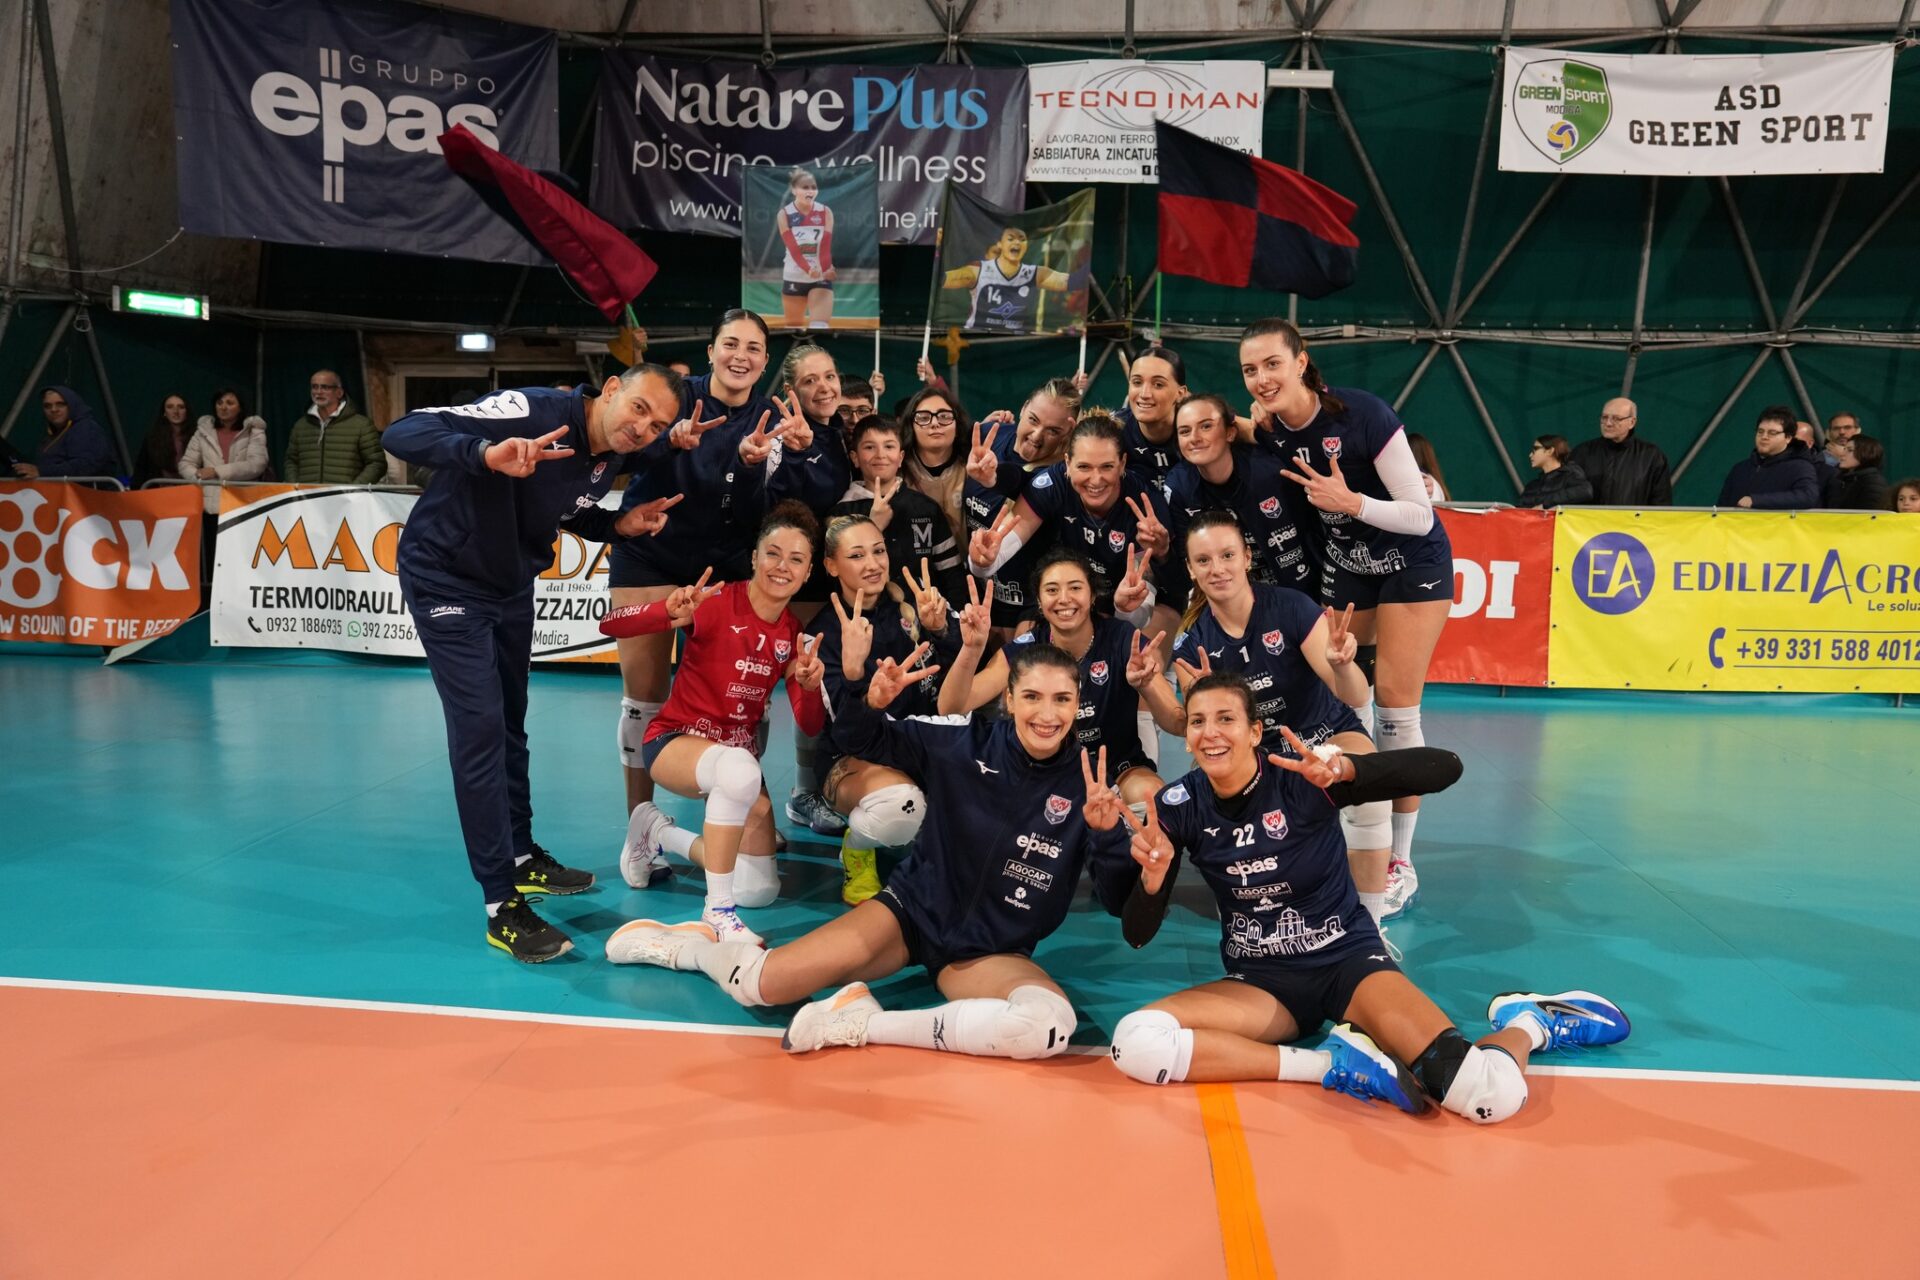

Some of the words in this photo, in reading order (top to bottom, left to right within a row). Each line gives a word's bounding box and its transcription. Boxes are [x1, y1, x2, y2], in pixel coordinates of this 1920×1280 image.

[349, 54, 496, 94] GRUPPO
[1519, 85, 1562, 101] GREEN
[1566, 88, 1606, 104] SPORT
[1714, 84, 1782, 111] ASD
[250, 71, 500, 163] epas
[1629, 119, 1741, 147] GREEN
[1761, 113, 1873, 144] SPORT
[1046, 134, 1116, 144] LAVORAZIONI
[1120, 134, 1155, 144] FERRO
[1213, 136, 1240, 145] INOX
[1032, 147, 1100, 160] SABBIATURA
[1031, 167, 1137, 176] WWW.TECNOIMAN.COM
[813, 229, 821, 241] 7
[987, 286, 1002, 304] 14
[1154, 451, 1169, 467] 11
[1296, 447, 1311, 464] 17
[911, 523, 933, 548] M
[1083, 527, 1095, 545] 13
[1267, 527, 1298, 552] epas
[1588, 549, 1641, 599] EA
[546, 582, 564, 593] dal
[1867, 600, 1885, 612] Le
[20, 614, 66, 635] SOUND
[69, 617, 98, 638] OF
[103, 618, 141, 640] THE
[266, 617, 297, 633] 0932
[301, 617, 342, 635] 1886935
[362, 622, 380, 639] 392
[533, 630, 569, 645] Modica
[1238, 645, 1250, 663] 1
[1737, 637, 1779, 660] +39
[1786, 637, 1822, 660] 331
[1831, 638, 1870, 661] 588
[735, 659, 771, 681] epas
[730, 685, 760, 695] AGOCAP
[1232, 823, 1255, 847] 22
[1016, 834, 1059, 859] epas
[1008, 863, 1046, 881] AGOCAP
[1226, 857, 1278, 882] epas
[1237, 885, 1282, 896] AGOCAP
